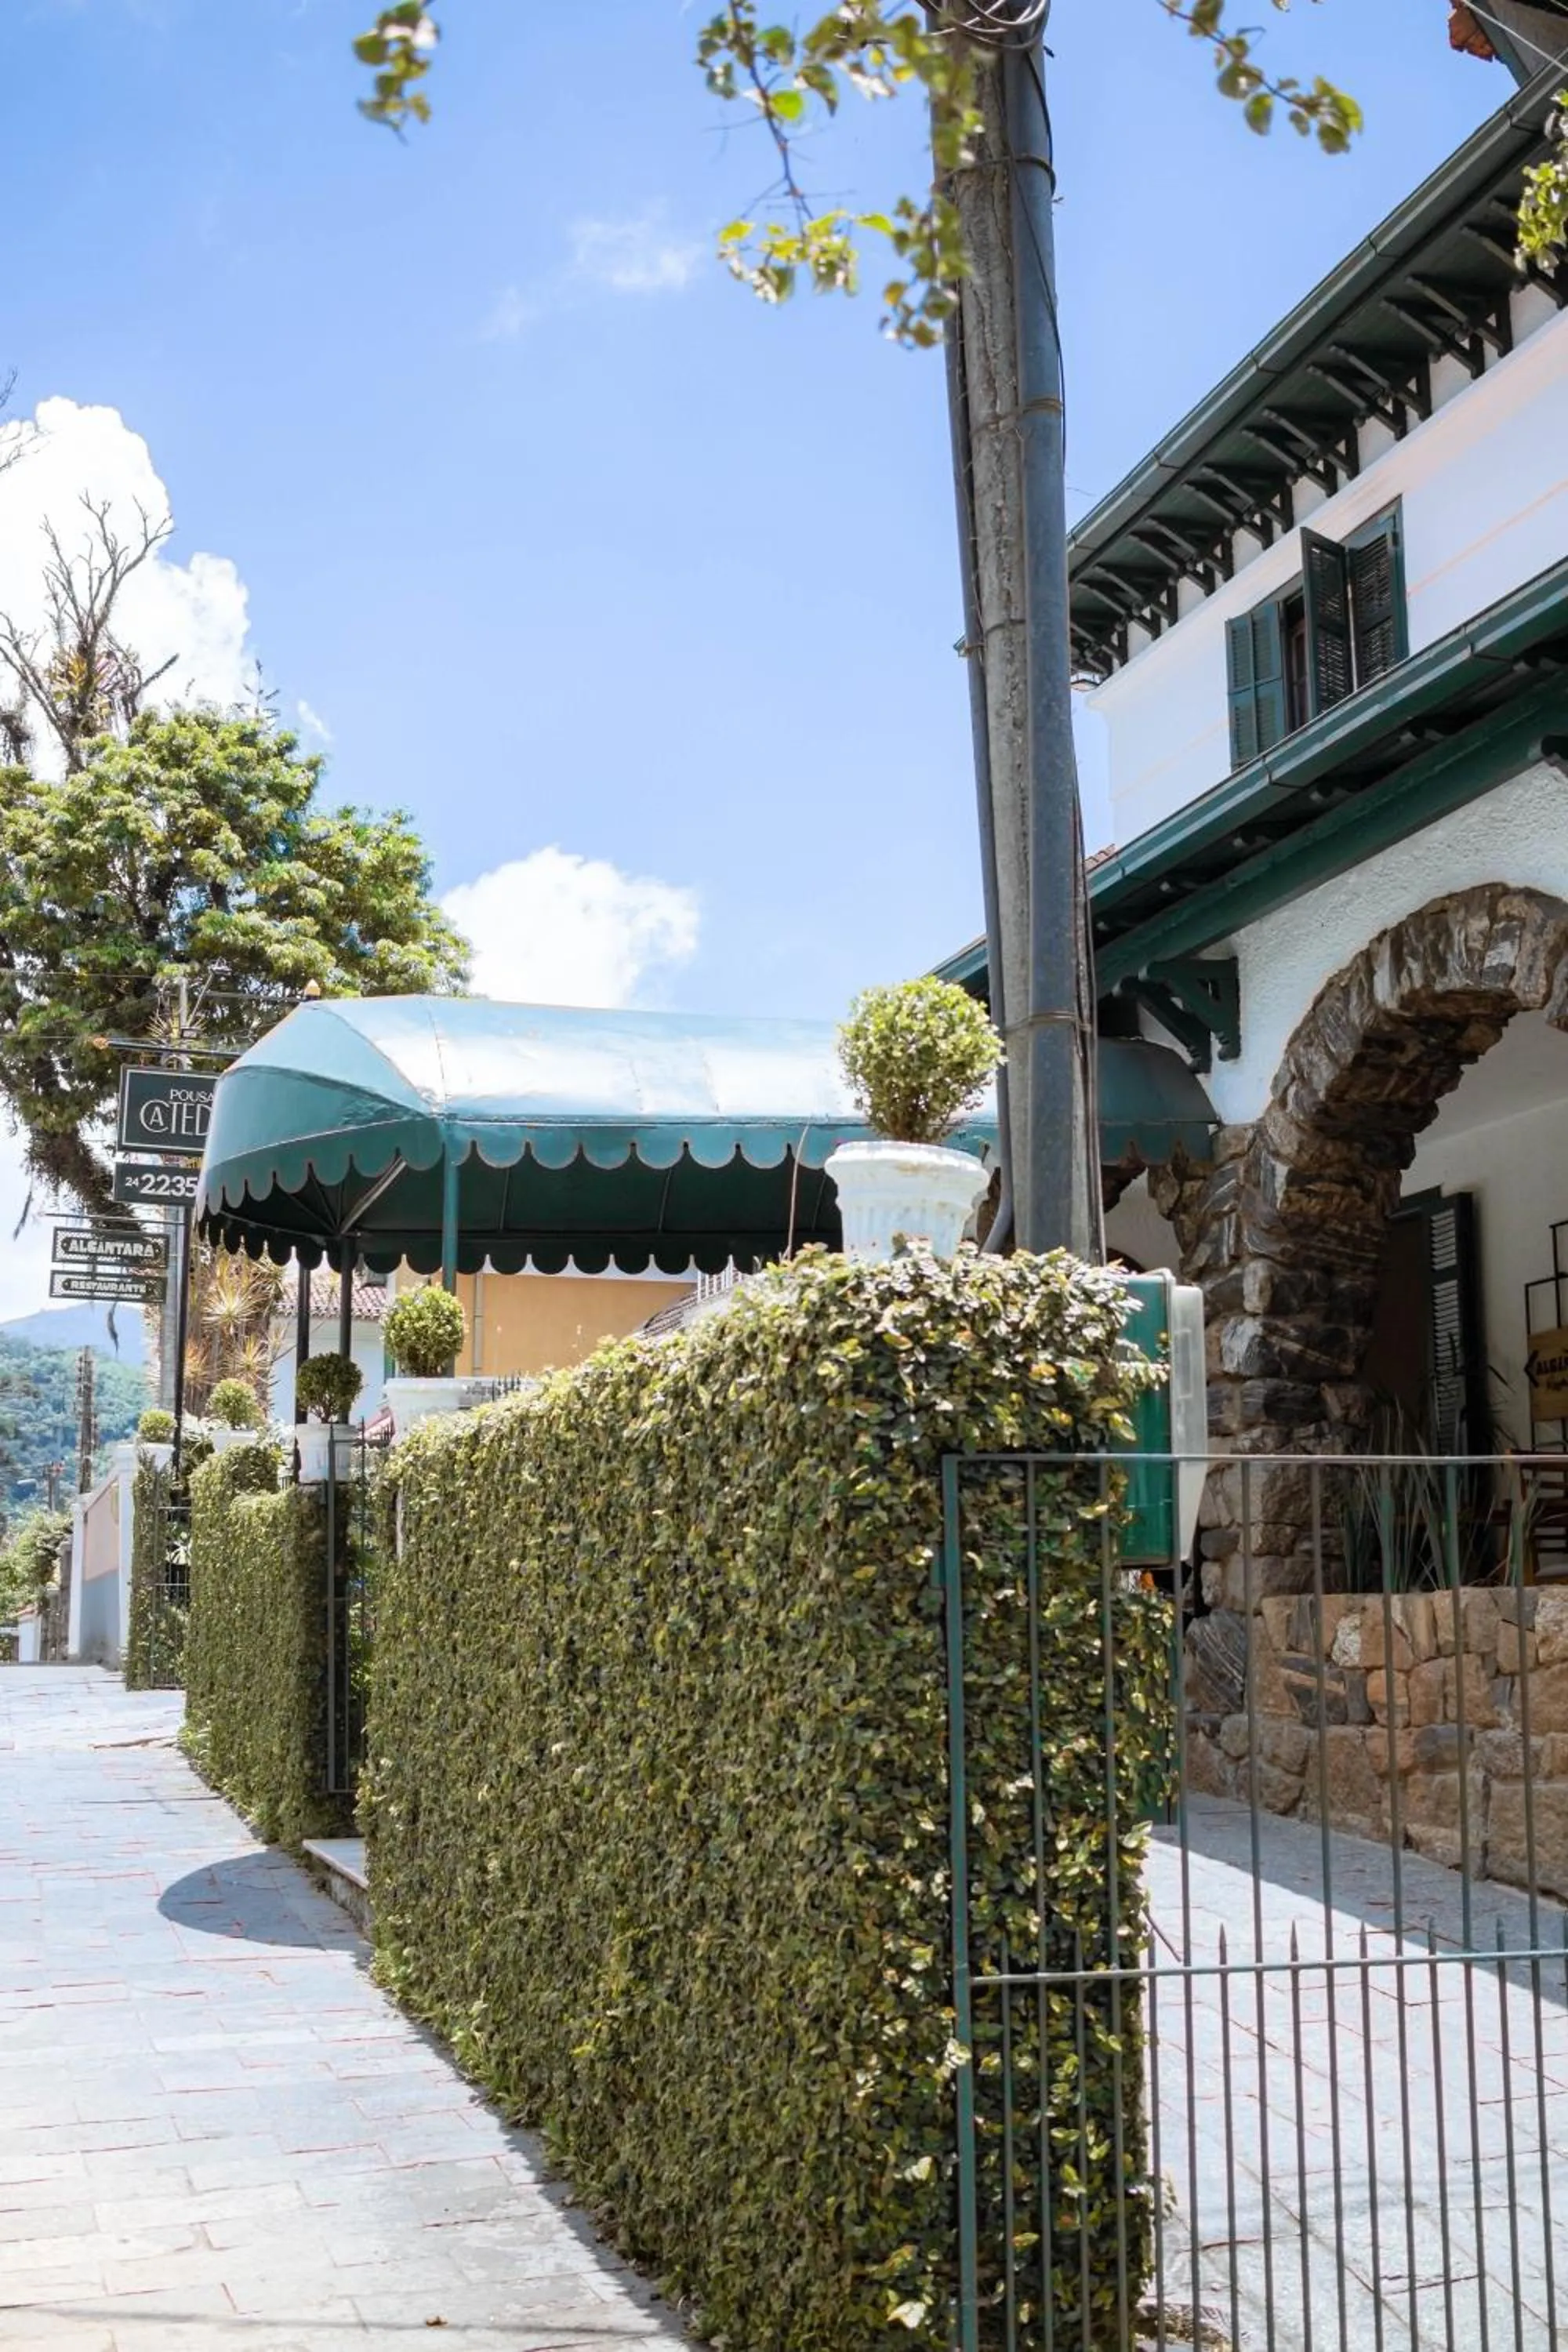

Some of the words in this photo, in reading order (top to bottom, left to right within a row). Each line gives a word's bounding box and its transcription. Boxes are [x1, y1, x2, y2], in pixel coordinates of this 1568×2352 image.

[125, 1177, 139, 1186] 24
[140, 1173, 198, 1197] 2235
[71, 1281, 147, 1294] RESTAURANTE
